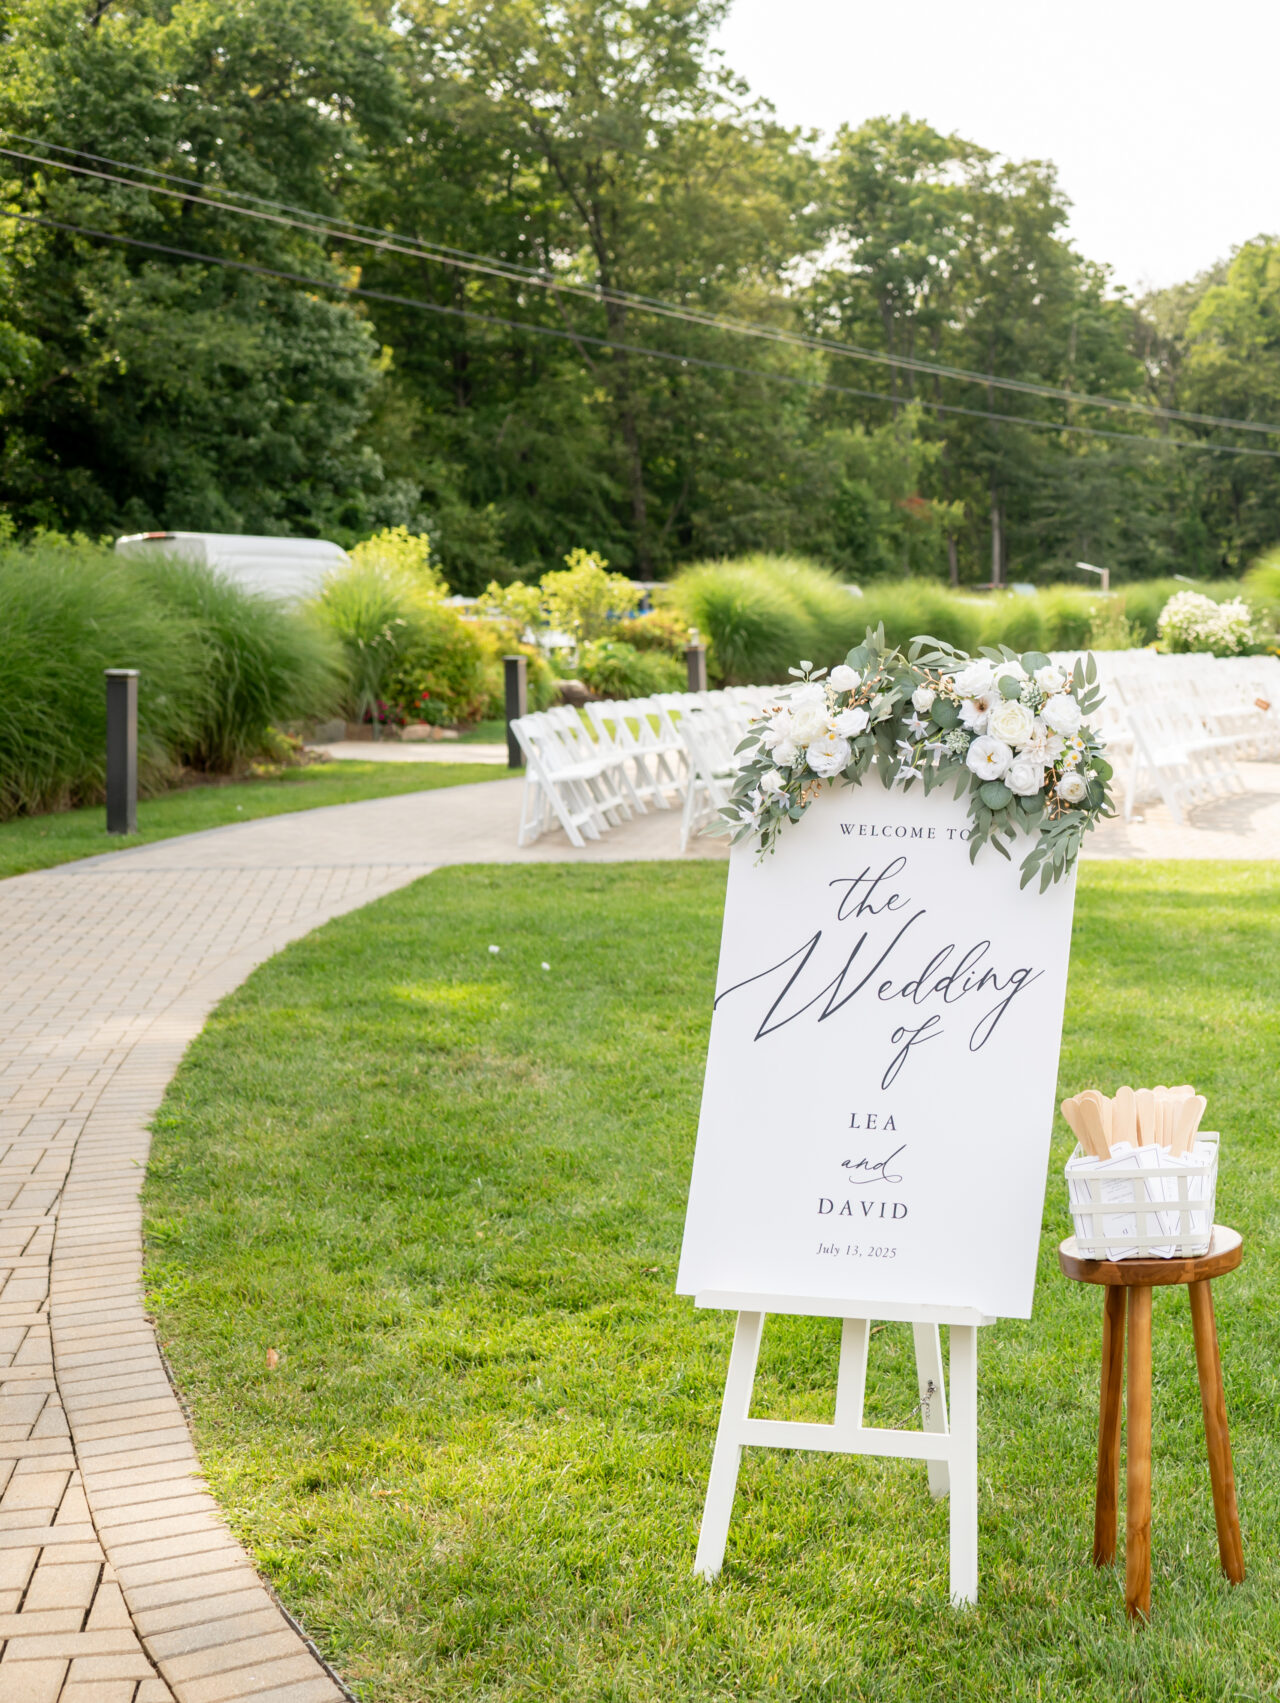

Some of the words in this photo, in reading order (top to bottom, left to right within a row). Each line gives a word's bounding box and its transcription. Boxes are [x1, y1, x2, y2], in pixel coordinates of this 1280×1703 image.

[840, 823, 936, 840] WELCOME
[946, 828, 972, 841] TO
[829, 856, 911, 921] the
[714, 909, 1045, 1052] Wedding
[881, 1014, 945, 1090] of
[849, 1112, 897, 1131] LEA
[841, 1143, 907, 1185] and
[817, 1197, 909, 1220] DAVID
[816, 1243, 840, 1257] July
[846, 1245, 863, 1258] 13,
[867, 1246, 897, 1259] 2025
